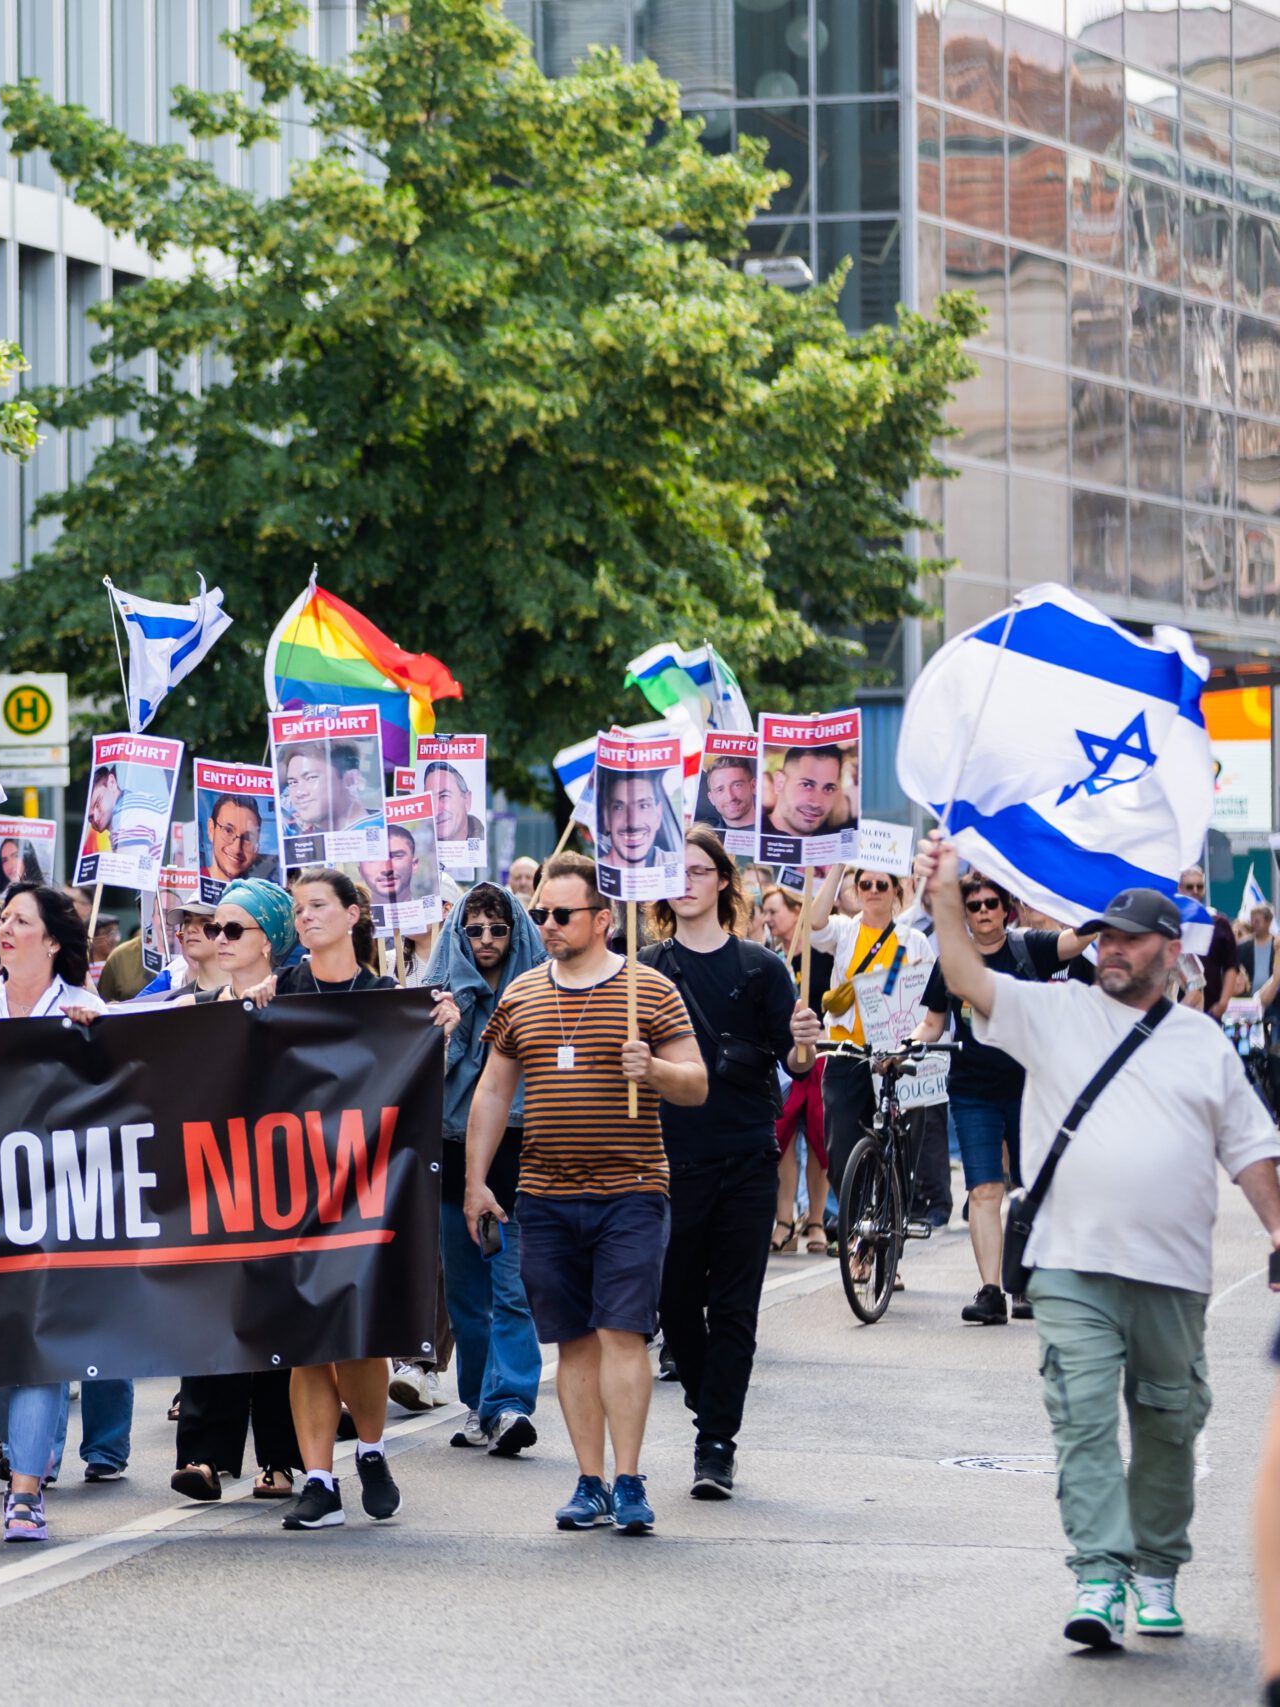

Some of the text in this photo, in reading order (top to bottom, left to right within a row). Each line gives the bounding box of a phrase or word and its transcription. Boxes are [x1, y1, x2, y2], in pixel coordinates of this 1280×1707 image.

[16, 697, 38, 723] H
[281, 716, 370, 736] ENTFÜHRT
[771, 721, 853, 740] ENTFÜHRT
[99, 742, 171, 761] ENTFÜHRT
[599, 745, 673, 762] ENTFÜHRT
[712, 738, 758, 751] ENTFÜ
[874, 829, 891, 839] EYES
[869, 842, 882, 850] ON
[182, 1105, 400, 1236] NOW
